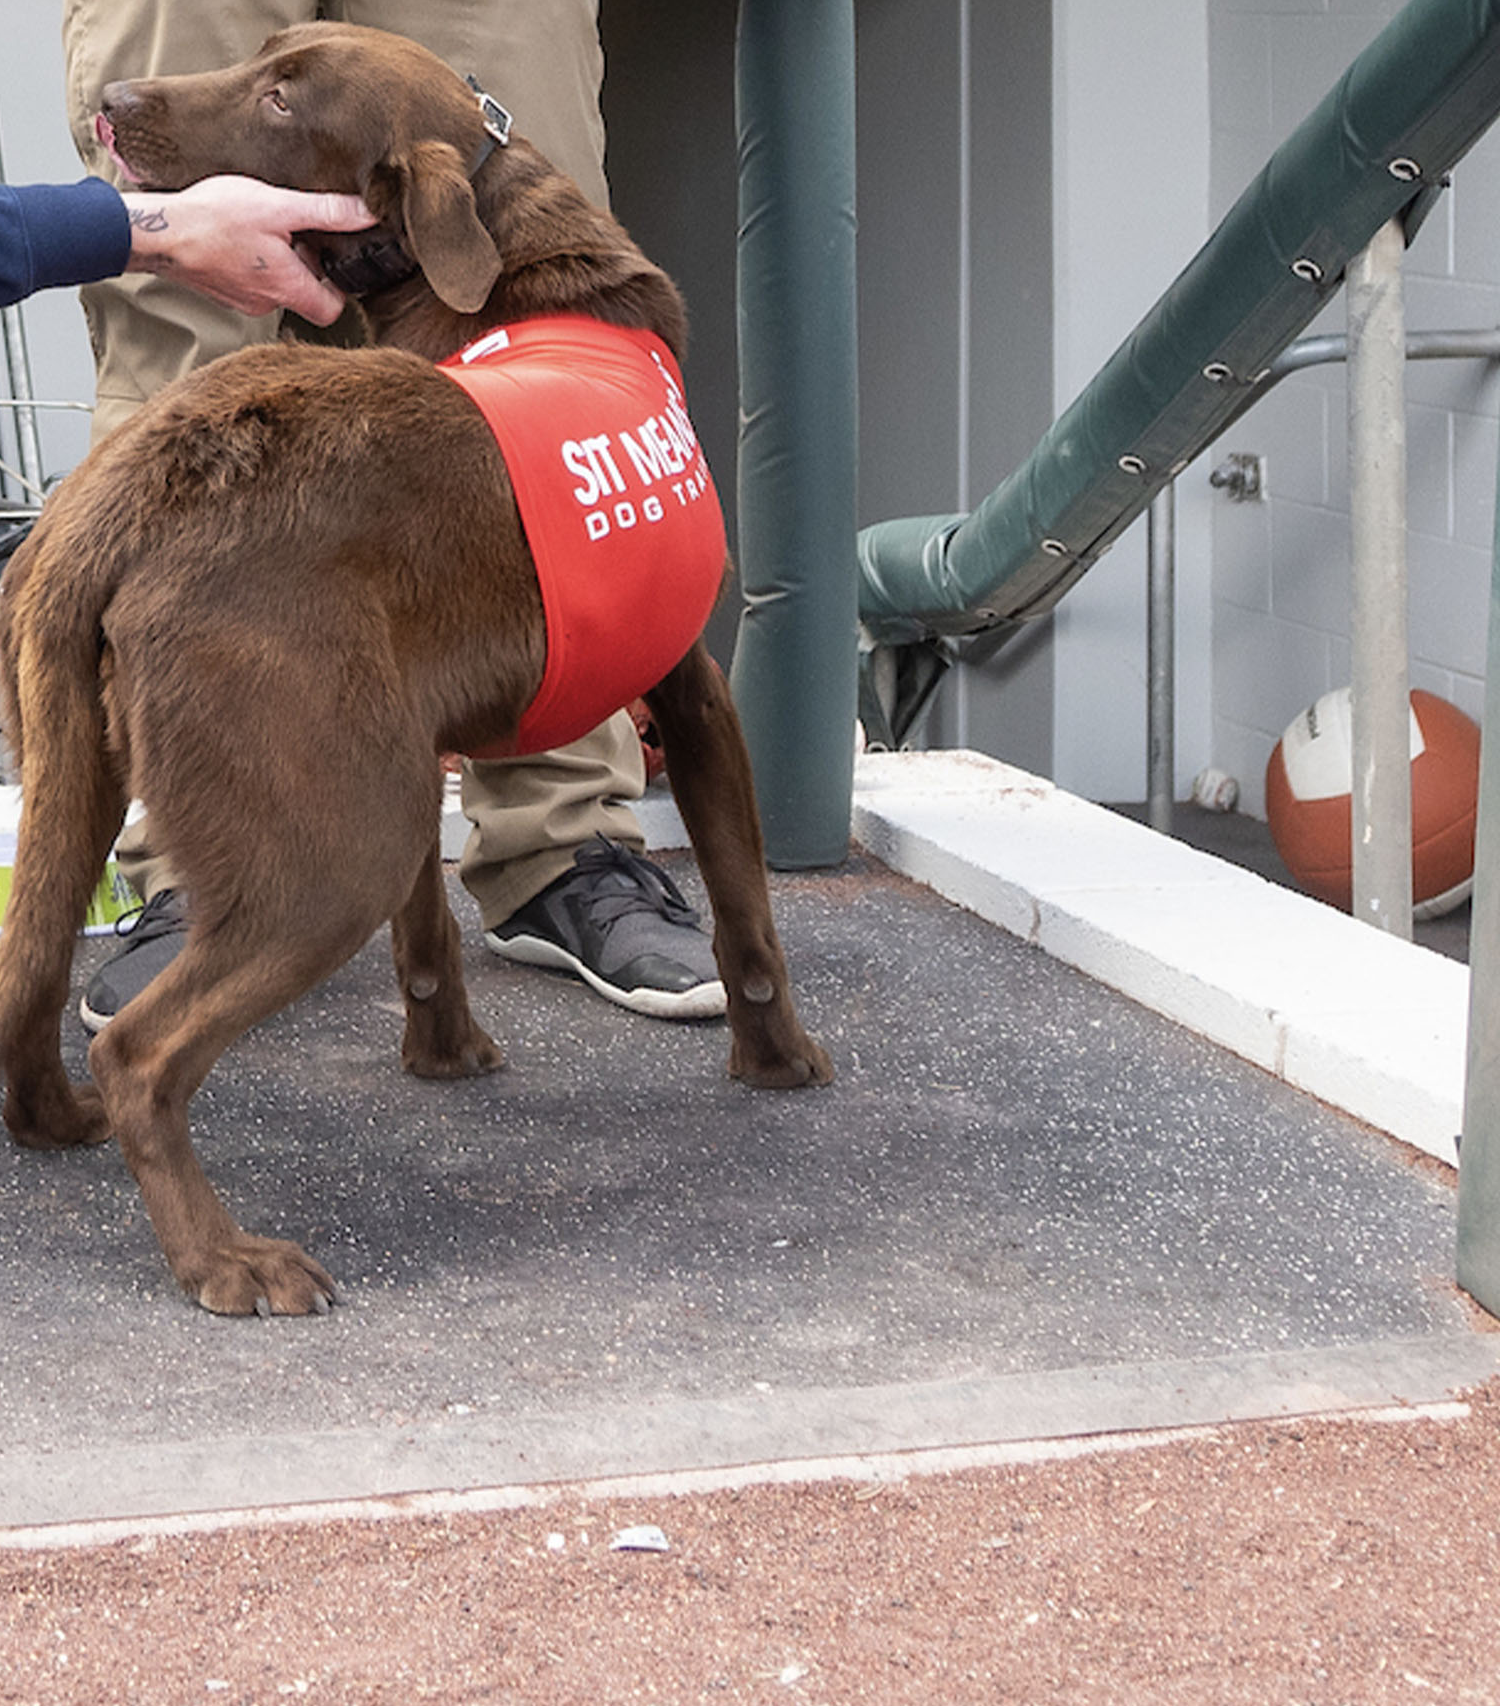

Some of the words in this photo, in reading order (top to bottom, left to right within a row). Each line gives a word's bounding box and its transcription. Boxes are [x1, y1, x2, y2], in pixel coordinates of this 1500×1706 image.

[561, 434, 627, 506] SIT
[619, 394, 698, 486] MEAN
[585, 495, 664, 541] DOG
[672, 454, 709, 507] TRA
